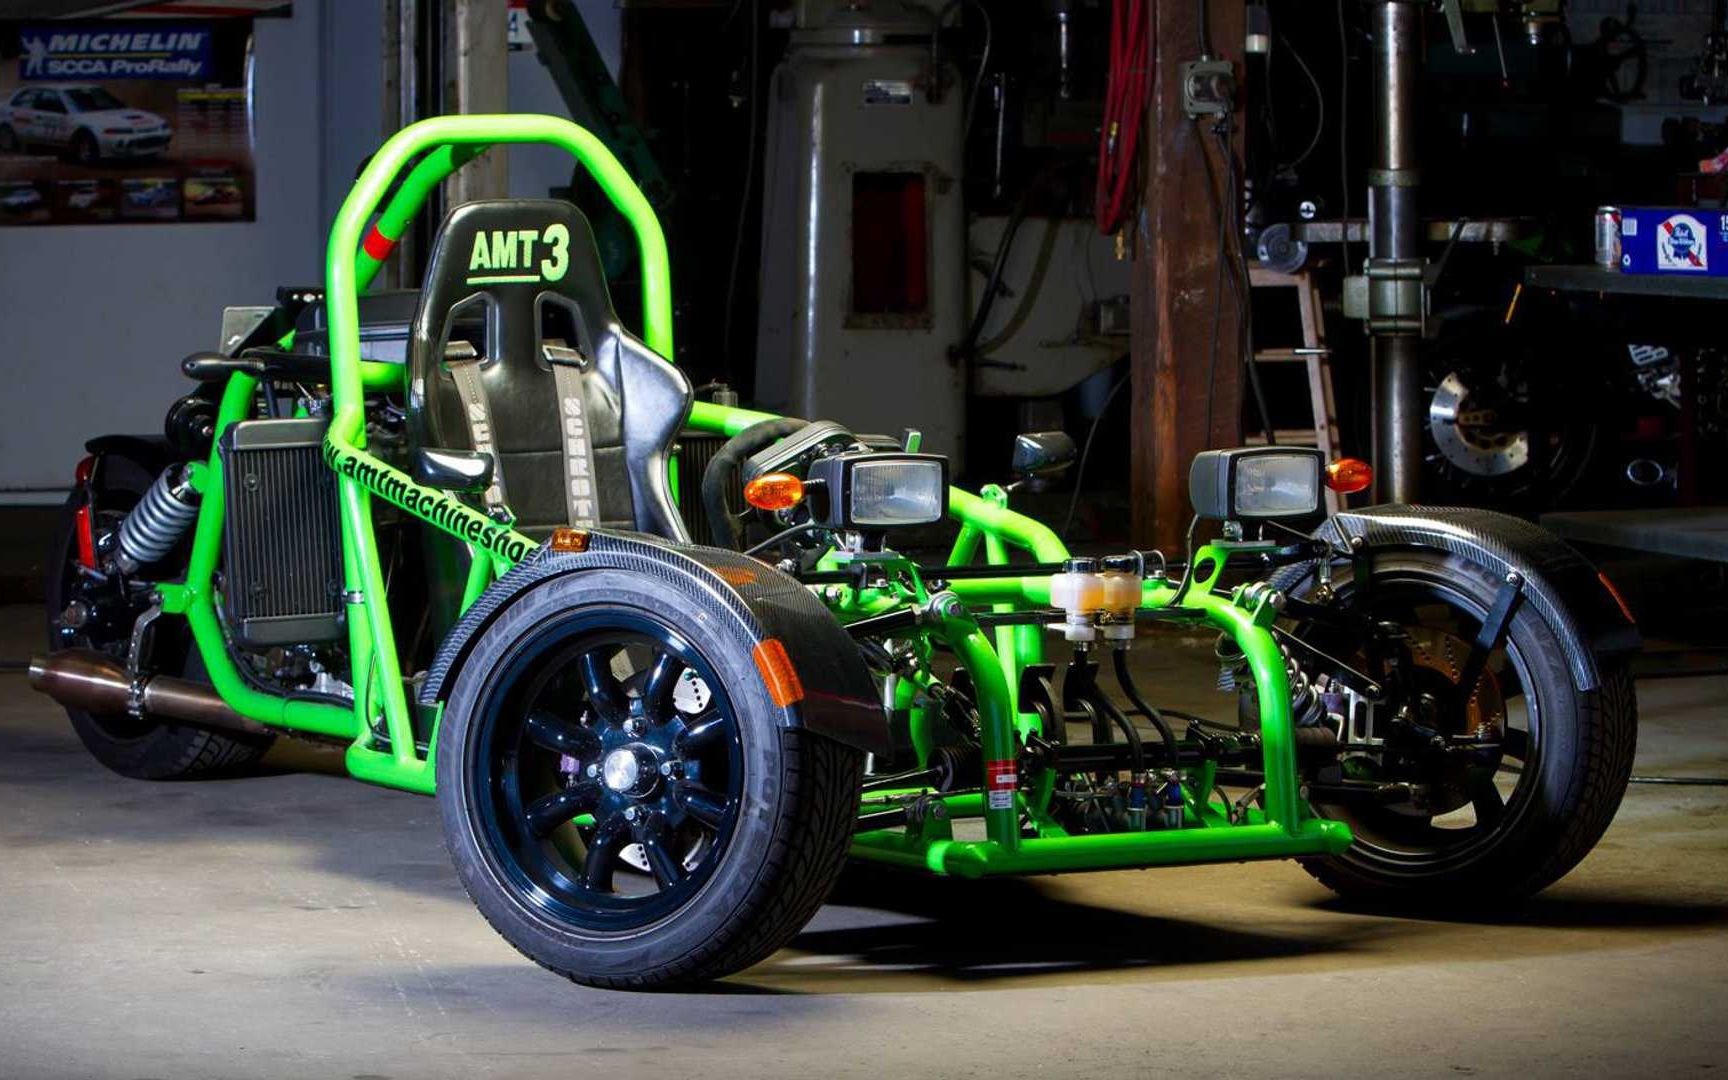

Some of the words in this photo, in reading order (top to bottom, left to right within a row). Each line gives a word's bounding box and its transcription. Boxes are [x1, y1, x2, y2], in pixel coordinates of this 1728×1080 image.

[48, 33, 202, 51] MICHELIN
[47, 59, 107, 74] SCCA
[110, 58, 202, 76] ProRally
[469, 230, 538, 270] AMT
[541, 223, 570, 282] 3
